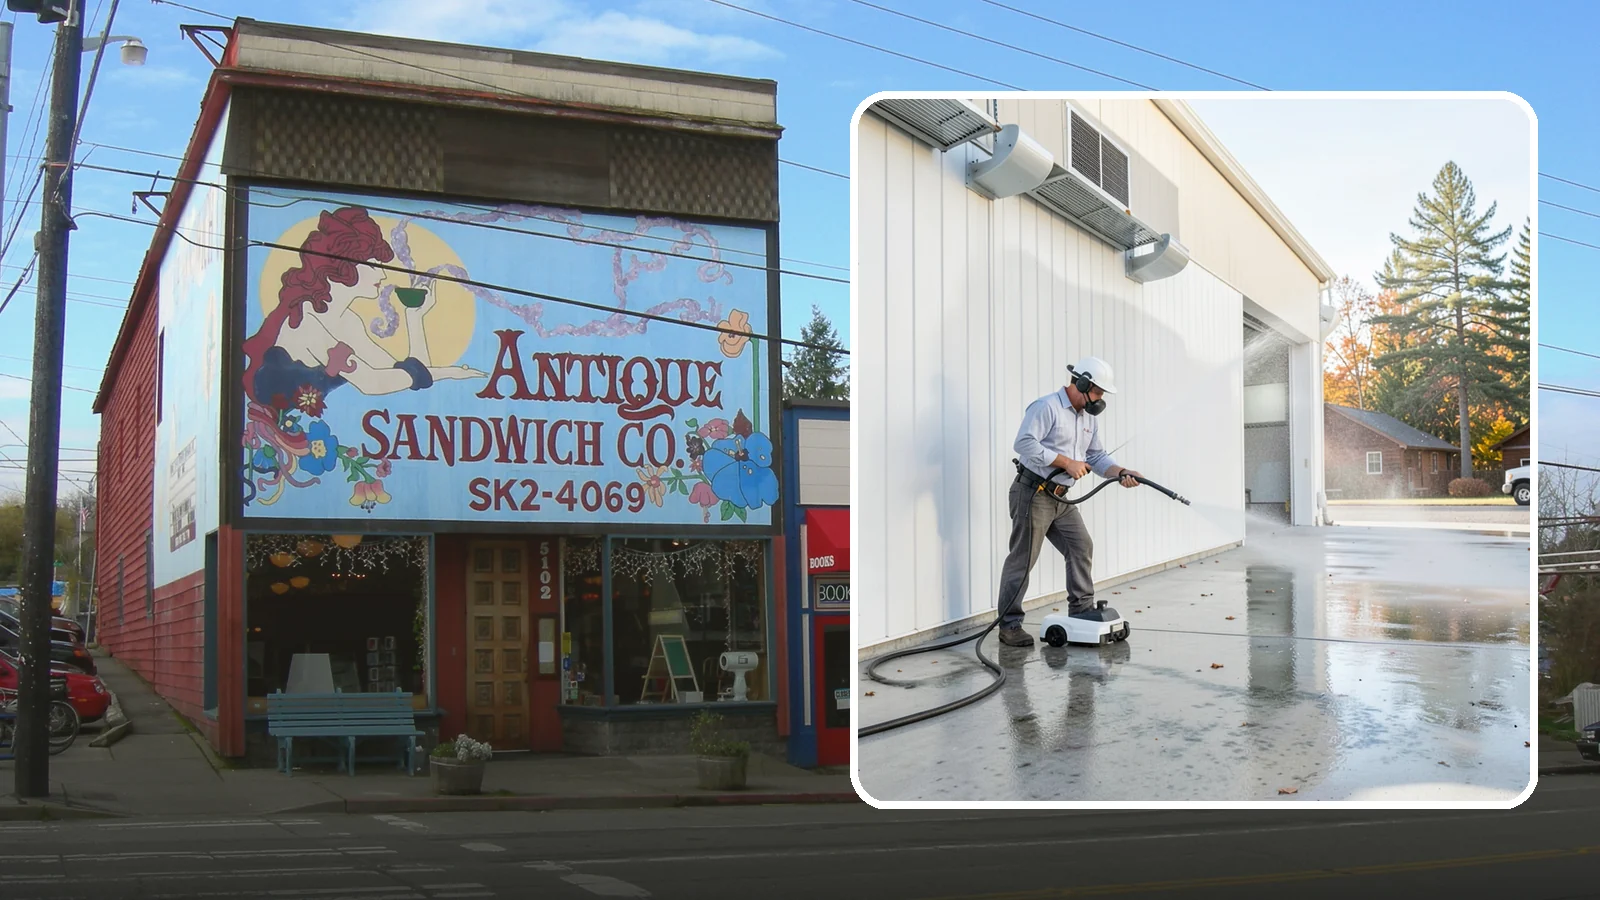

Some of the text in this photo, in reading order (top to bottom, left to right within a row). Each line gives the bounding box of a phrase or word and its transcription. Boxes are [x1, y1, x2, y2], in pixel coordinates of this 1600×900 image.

[475, 329, 724, 421] ANTIQUE
[361, 408, 685, 468] SANDWICH CO.
[468, 477, 646, 513] SK2-4069
[539, 542, 551, 600] 5102
[809, 555, 835, 569] BOOKS
